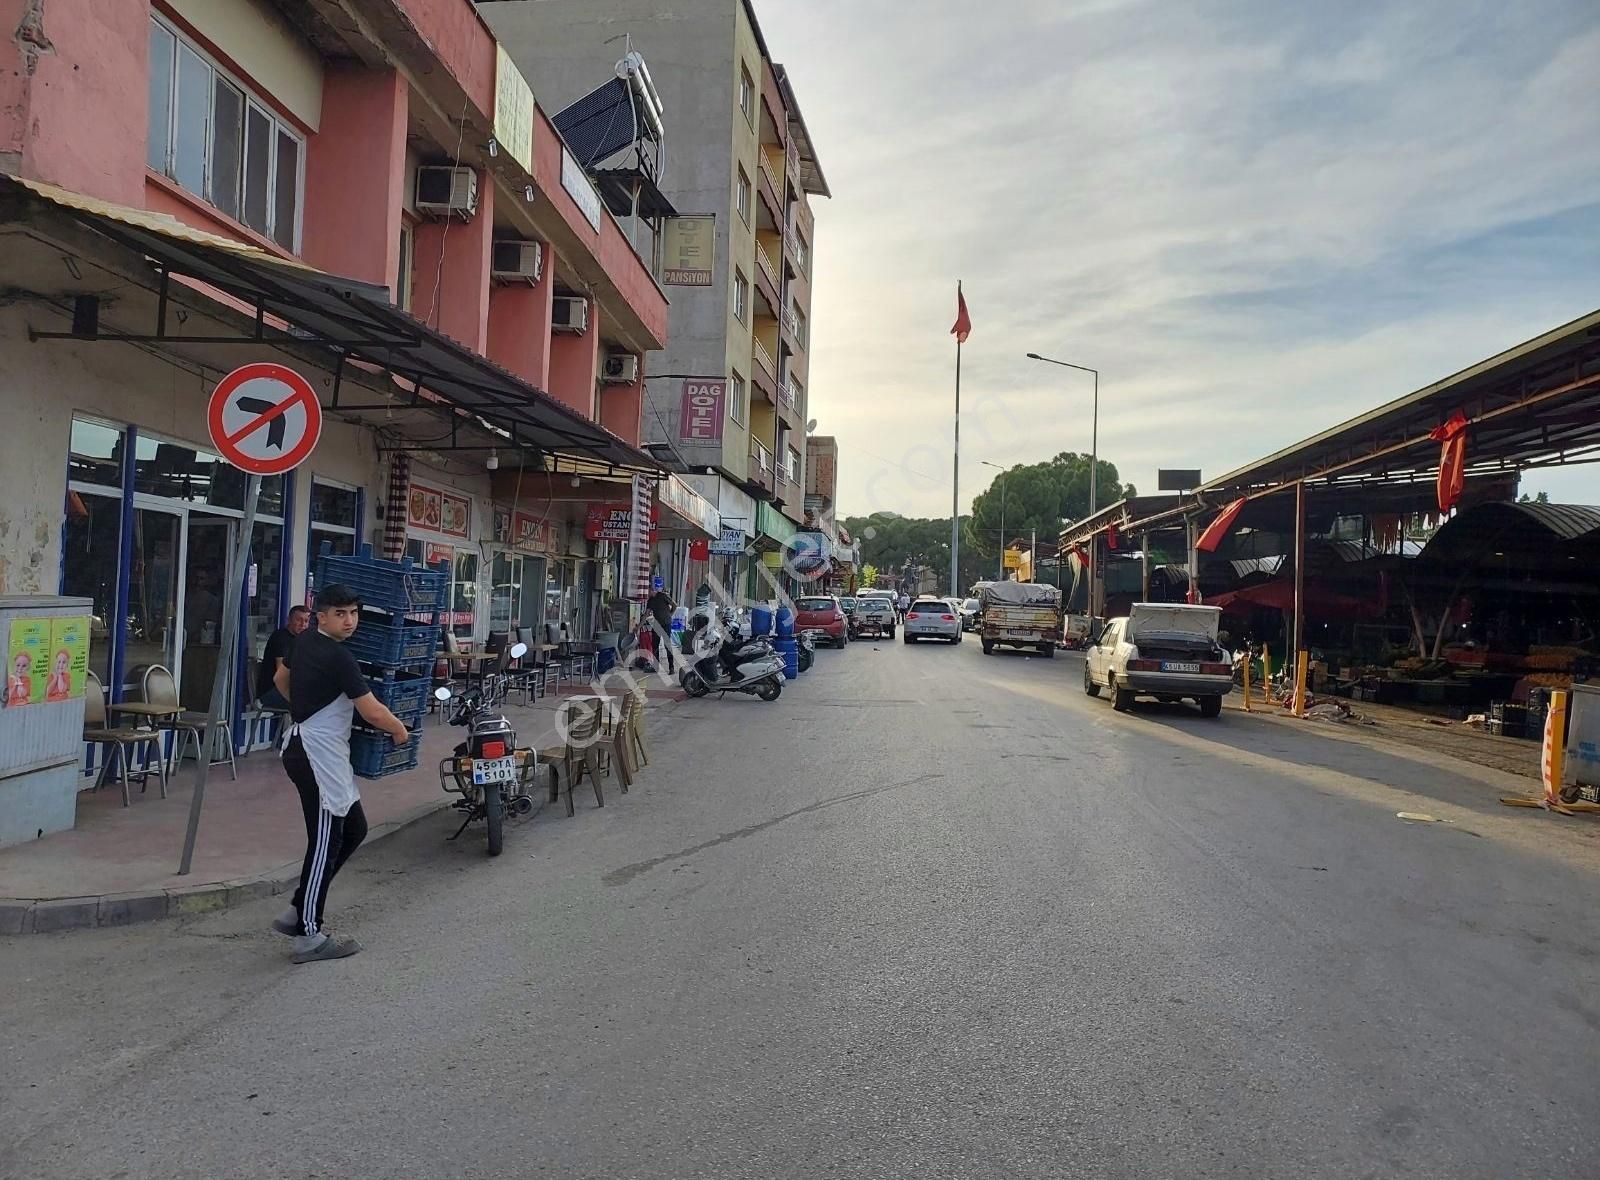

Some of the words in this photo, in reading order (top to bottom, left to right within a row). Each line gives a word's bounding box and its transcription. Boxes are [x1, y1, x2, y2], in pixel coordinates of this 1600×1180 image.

[691, 396, 715, 438] OTEL
[476, 761, 490, 771] 45
[498, 759, 511, 769] TA
[484, 770, 511, 780] 5101
